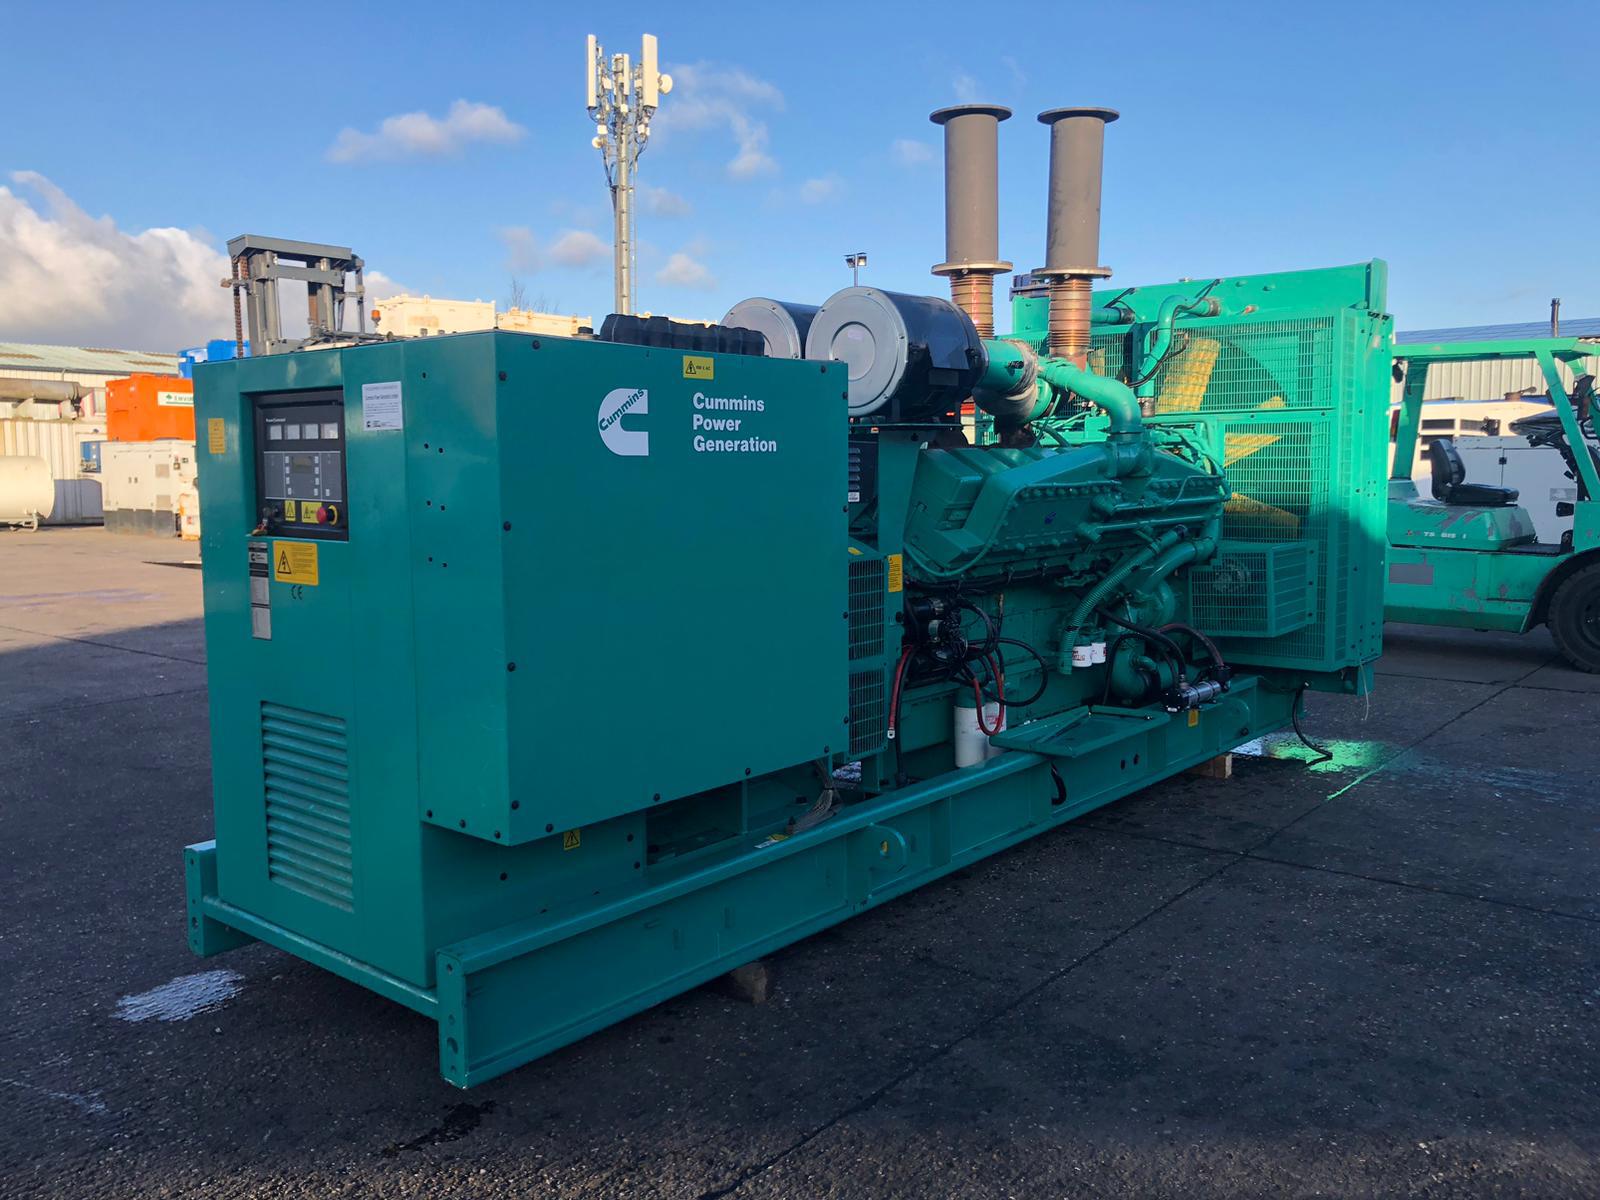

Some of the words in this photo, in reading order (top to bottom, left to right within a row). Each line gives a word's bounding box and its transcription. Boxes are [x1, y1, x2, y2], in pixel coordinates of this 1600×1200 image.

[599, 389, 644, 431] Cummins
[693, 392, 764, 411] Cummins
[693, 414, 741, 431] Power
[693, 435, 777, 452] Generation
